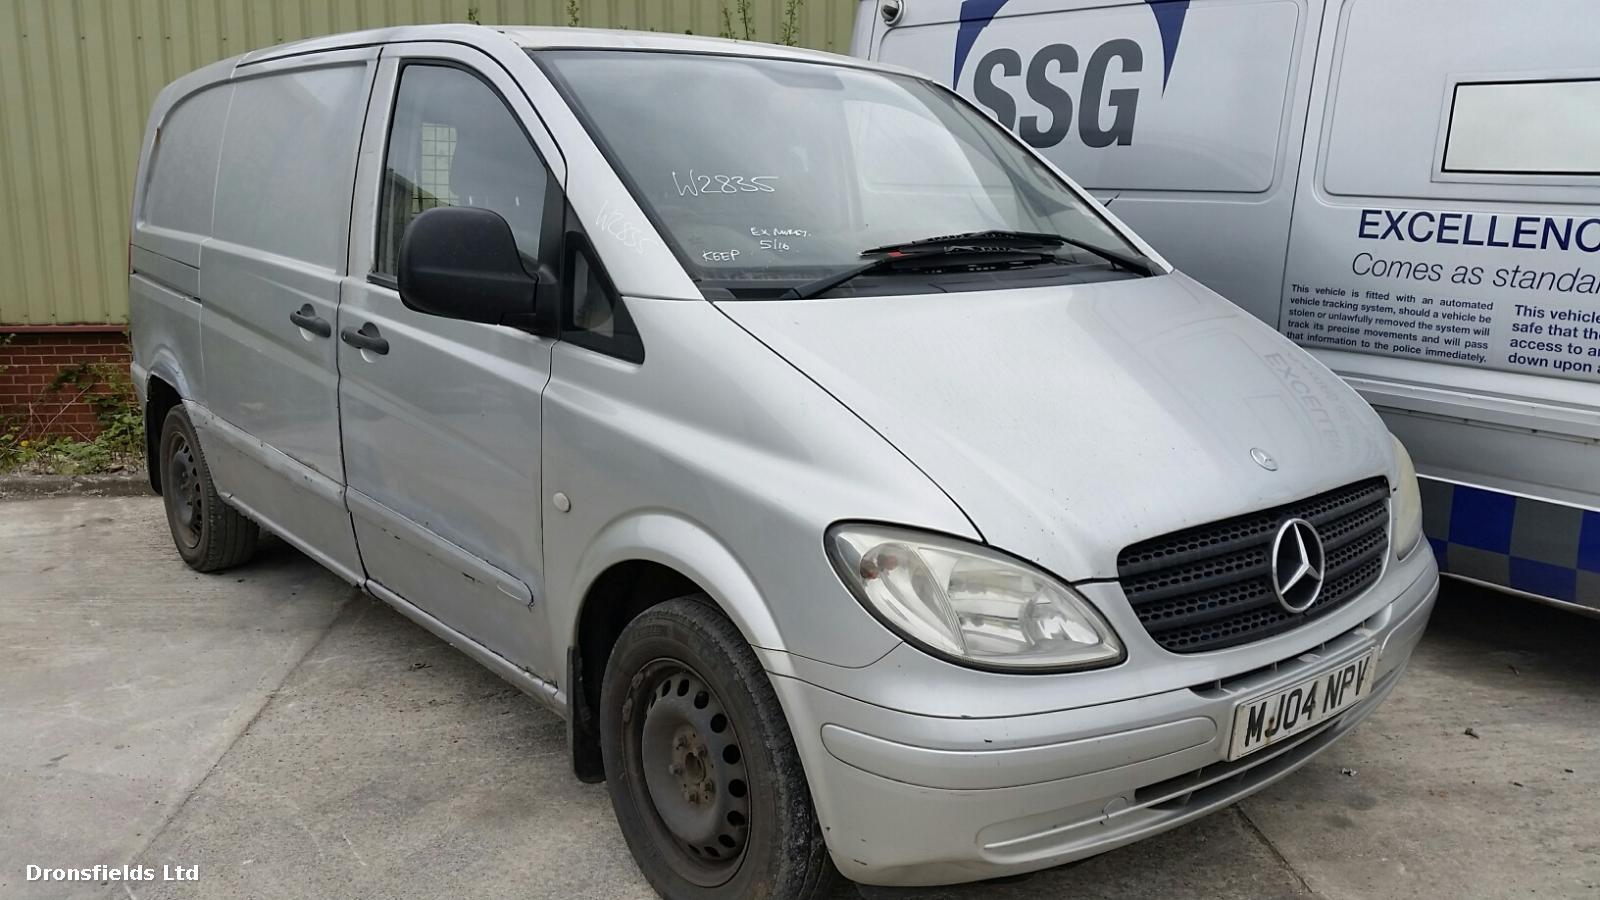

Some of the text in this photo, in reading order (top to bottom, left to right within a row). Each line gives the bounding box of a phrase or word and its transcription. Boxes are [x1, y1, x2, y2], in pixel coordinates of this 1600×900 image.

[973, 38, 1144, 149] SSG
[672, 169, 779, 197] W2835
[702, 249, 741, 263] KEEP
[1352, 252, 1443, 282] Comes
[1451, 265, 1484, 285] as
[1290, 296, 1321, 307] vehicle
[1322, 299, 1359, 312] tracking
[1360, 303, 1396, 315] system,
[1398, 306, 1431, 318] should
[1441, 311, 1477, 323] vehicle
[1478, 314, 1492, 324] be
[1291, 283, 1494, 311] This vehicle is fitted with an automated
[1288, 308, 1315, 318] stolen
[1328, 312, 1373, 326] unlawfully
[1375, 317, 1416, 329] removed
[1417, 321, 1433, 331] the
[1435, 323, 1471, 335] system
[1472, 327, 1490, 337] will
[1514, 304, 1545, 319] This
[1287, 319, 1489, 350] track its precise movements and will pass
[1511, 321, 1600, 341] safe that th
[1286, 331, 1487, 364] that information to the police immediately.
[1509, 338, 1563, 353] access
[1567, 342, 1583, 355] to
[1508, 352, 1549, 368] down
[1553, 359, 1592, 374] upon
[1322, 656, 1371, 714] NPV
